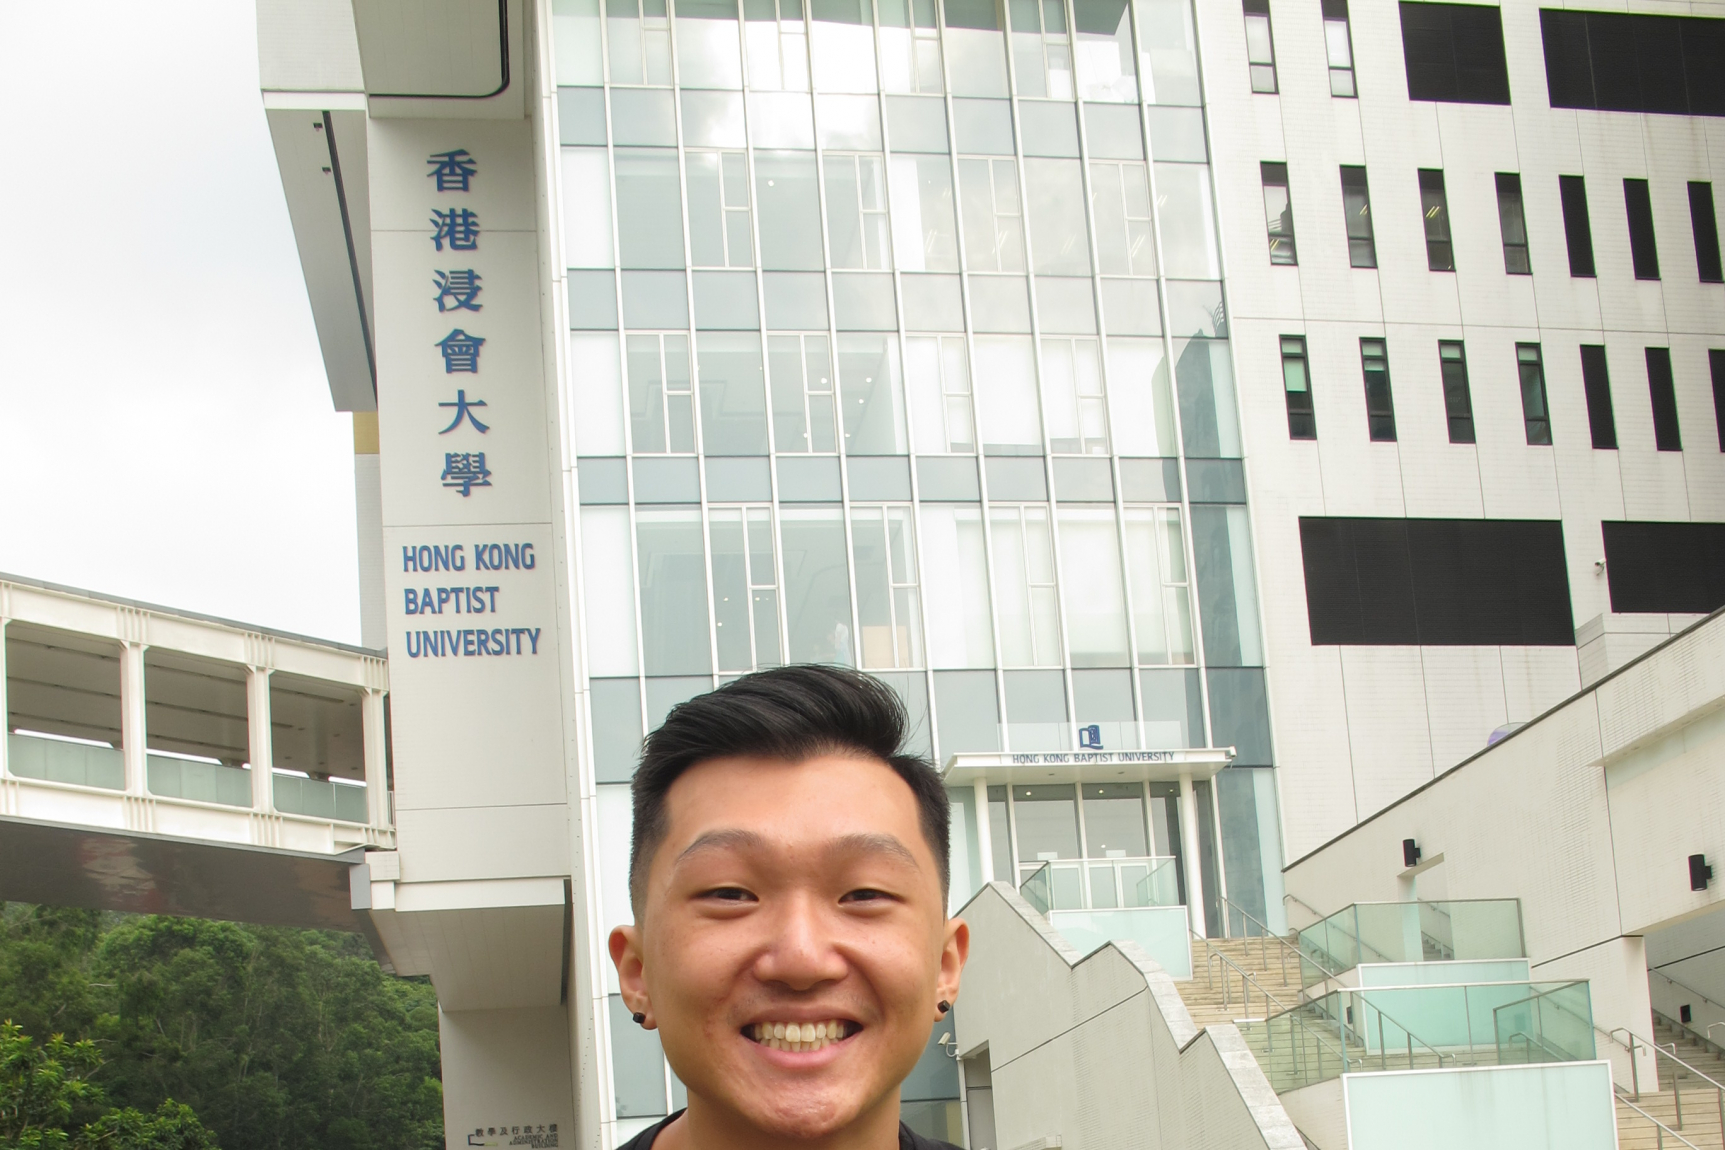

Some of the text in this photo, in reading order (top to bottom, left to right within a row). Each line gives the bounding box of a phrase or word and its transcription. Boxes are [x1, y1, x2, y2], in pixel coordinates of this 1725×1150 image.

[426, 148, 493, 498] 香港浸會大學
[402, 542, 536, 573] HONG KONG
[404, 586, 500, 616] BAPTIST
[405, 627, 541, 659] UNIVERSITY
[1012, 751, 1175, 764] HONG KONG BAPTIST UNIVERSITY
[475, 1123, 558, 1138] 教學及行政大樓
